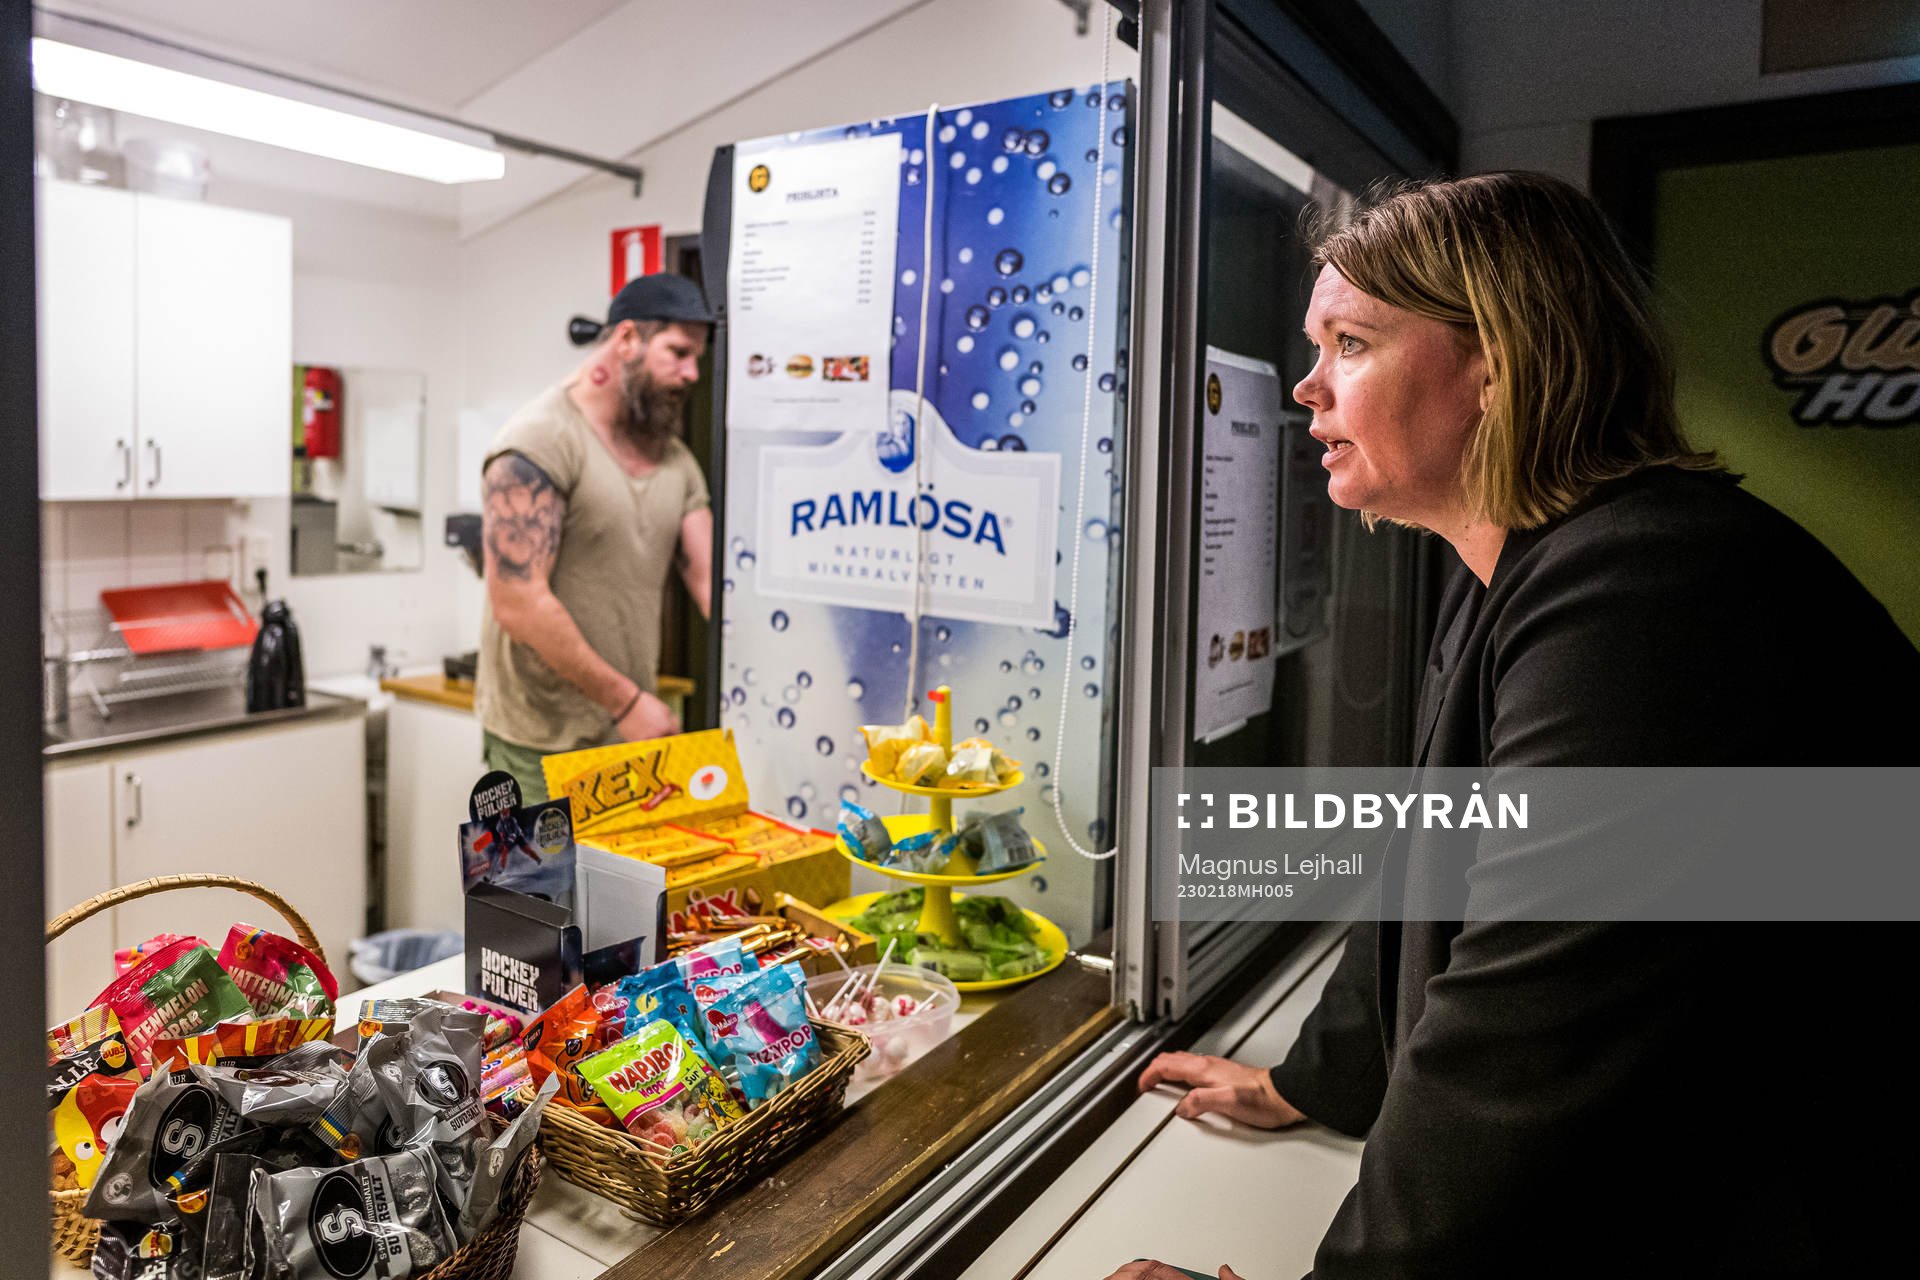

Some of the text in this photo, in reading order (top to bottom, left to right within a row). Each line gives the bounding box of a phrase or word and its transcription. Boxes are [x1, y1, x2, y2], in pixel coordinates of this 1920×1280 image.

[473, 779, 515, 809] HOCKEY
[476, 793, 518, 821] PULVER
[564, 750, 664, 824] KEX
[481, 946, 540, 989] HOCKEY
[481, 969, 538, 1011] PULVER
[126, 977, 210, 1055] TTENMELON
[102, 1045, 126, 1060] BUBS
[607, 1042, 685, 1095] HARIBO
[638, 1079, 668, 1099] Napp
[685, 1070, 700, 1086] Sur
[161, 1118, 206, 1160] S
[318, 1207, 368, 1245] S
[371, 1174, 402, 1256] SURSALT
